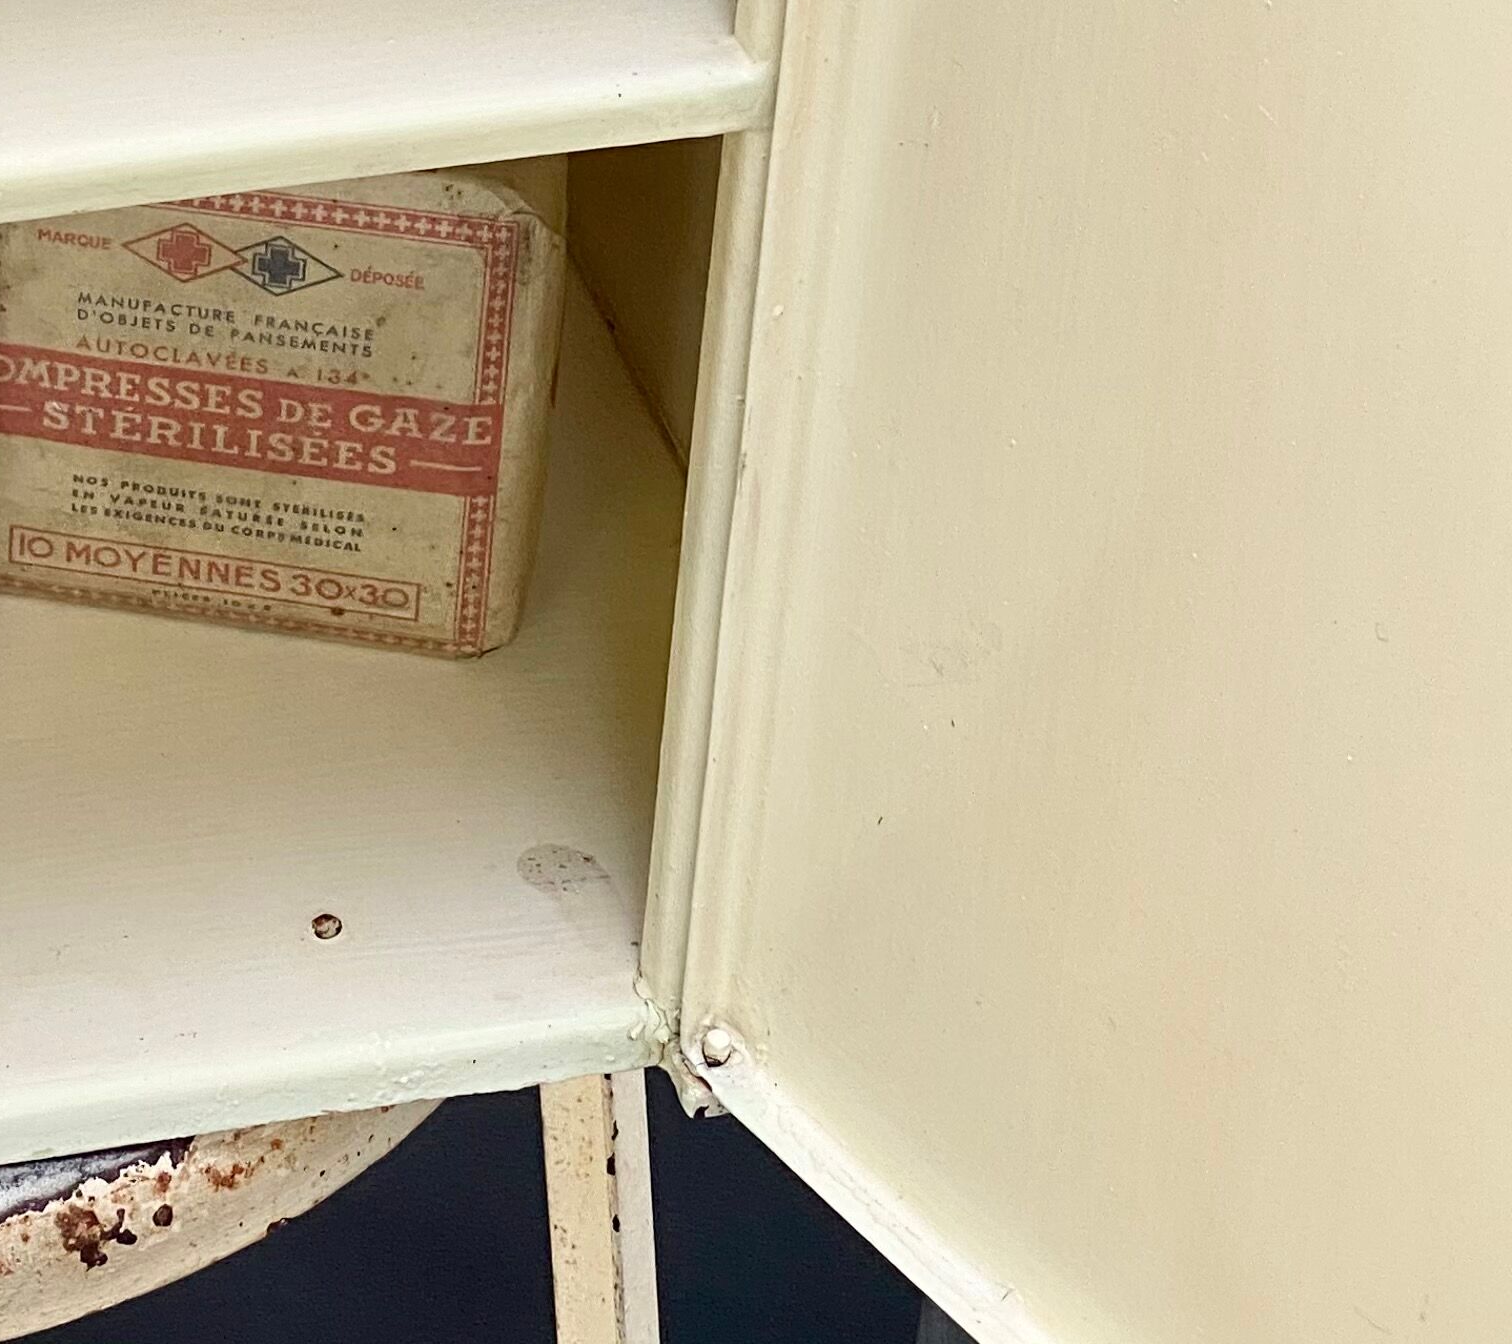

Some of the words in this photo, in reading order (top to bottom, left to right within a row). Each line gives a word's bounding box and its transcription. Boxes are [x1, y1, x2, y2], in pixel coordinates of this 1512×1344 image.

[37, 227, 113, 251] MARQUE
[350, 264, 426, 292] DÉPOSÉE
[76, 308, 177, 334] D'OBJETS
[189, 321, 215, 338] DE
[229, 330, 374, 360] PANSEMENTS
[77, 291, 237, 325] MANUFACTURE
[254, 313, 376, 342] FRANÇAISE
[75, 334, 269, 376] AUTOCLAVÉES
[42, 399, 398, 476] STÉRILISÉES
[276, 398, 333, 429] DE
[348, 403, 494, 447] GAZE
[71, 488, 96, 501] EN
[109, 492, 186, 514] VAPEUR
[299, 519, 365, 539] SELON
[72, 473, 110, 488] NOS
[120, 480, 207, 502] PRODUITS
[215, 493, 263, 510] SONT
[71, 502, 99, 516] LES
[103, 507, 197, 530] EXIGENCES
[202, 521, 226, 534] DU
[18, 531, 54, 559] 10
[65, 540, 282, 594] MOYENNES
